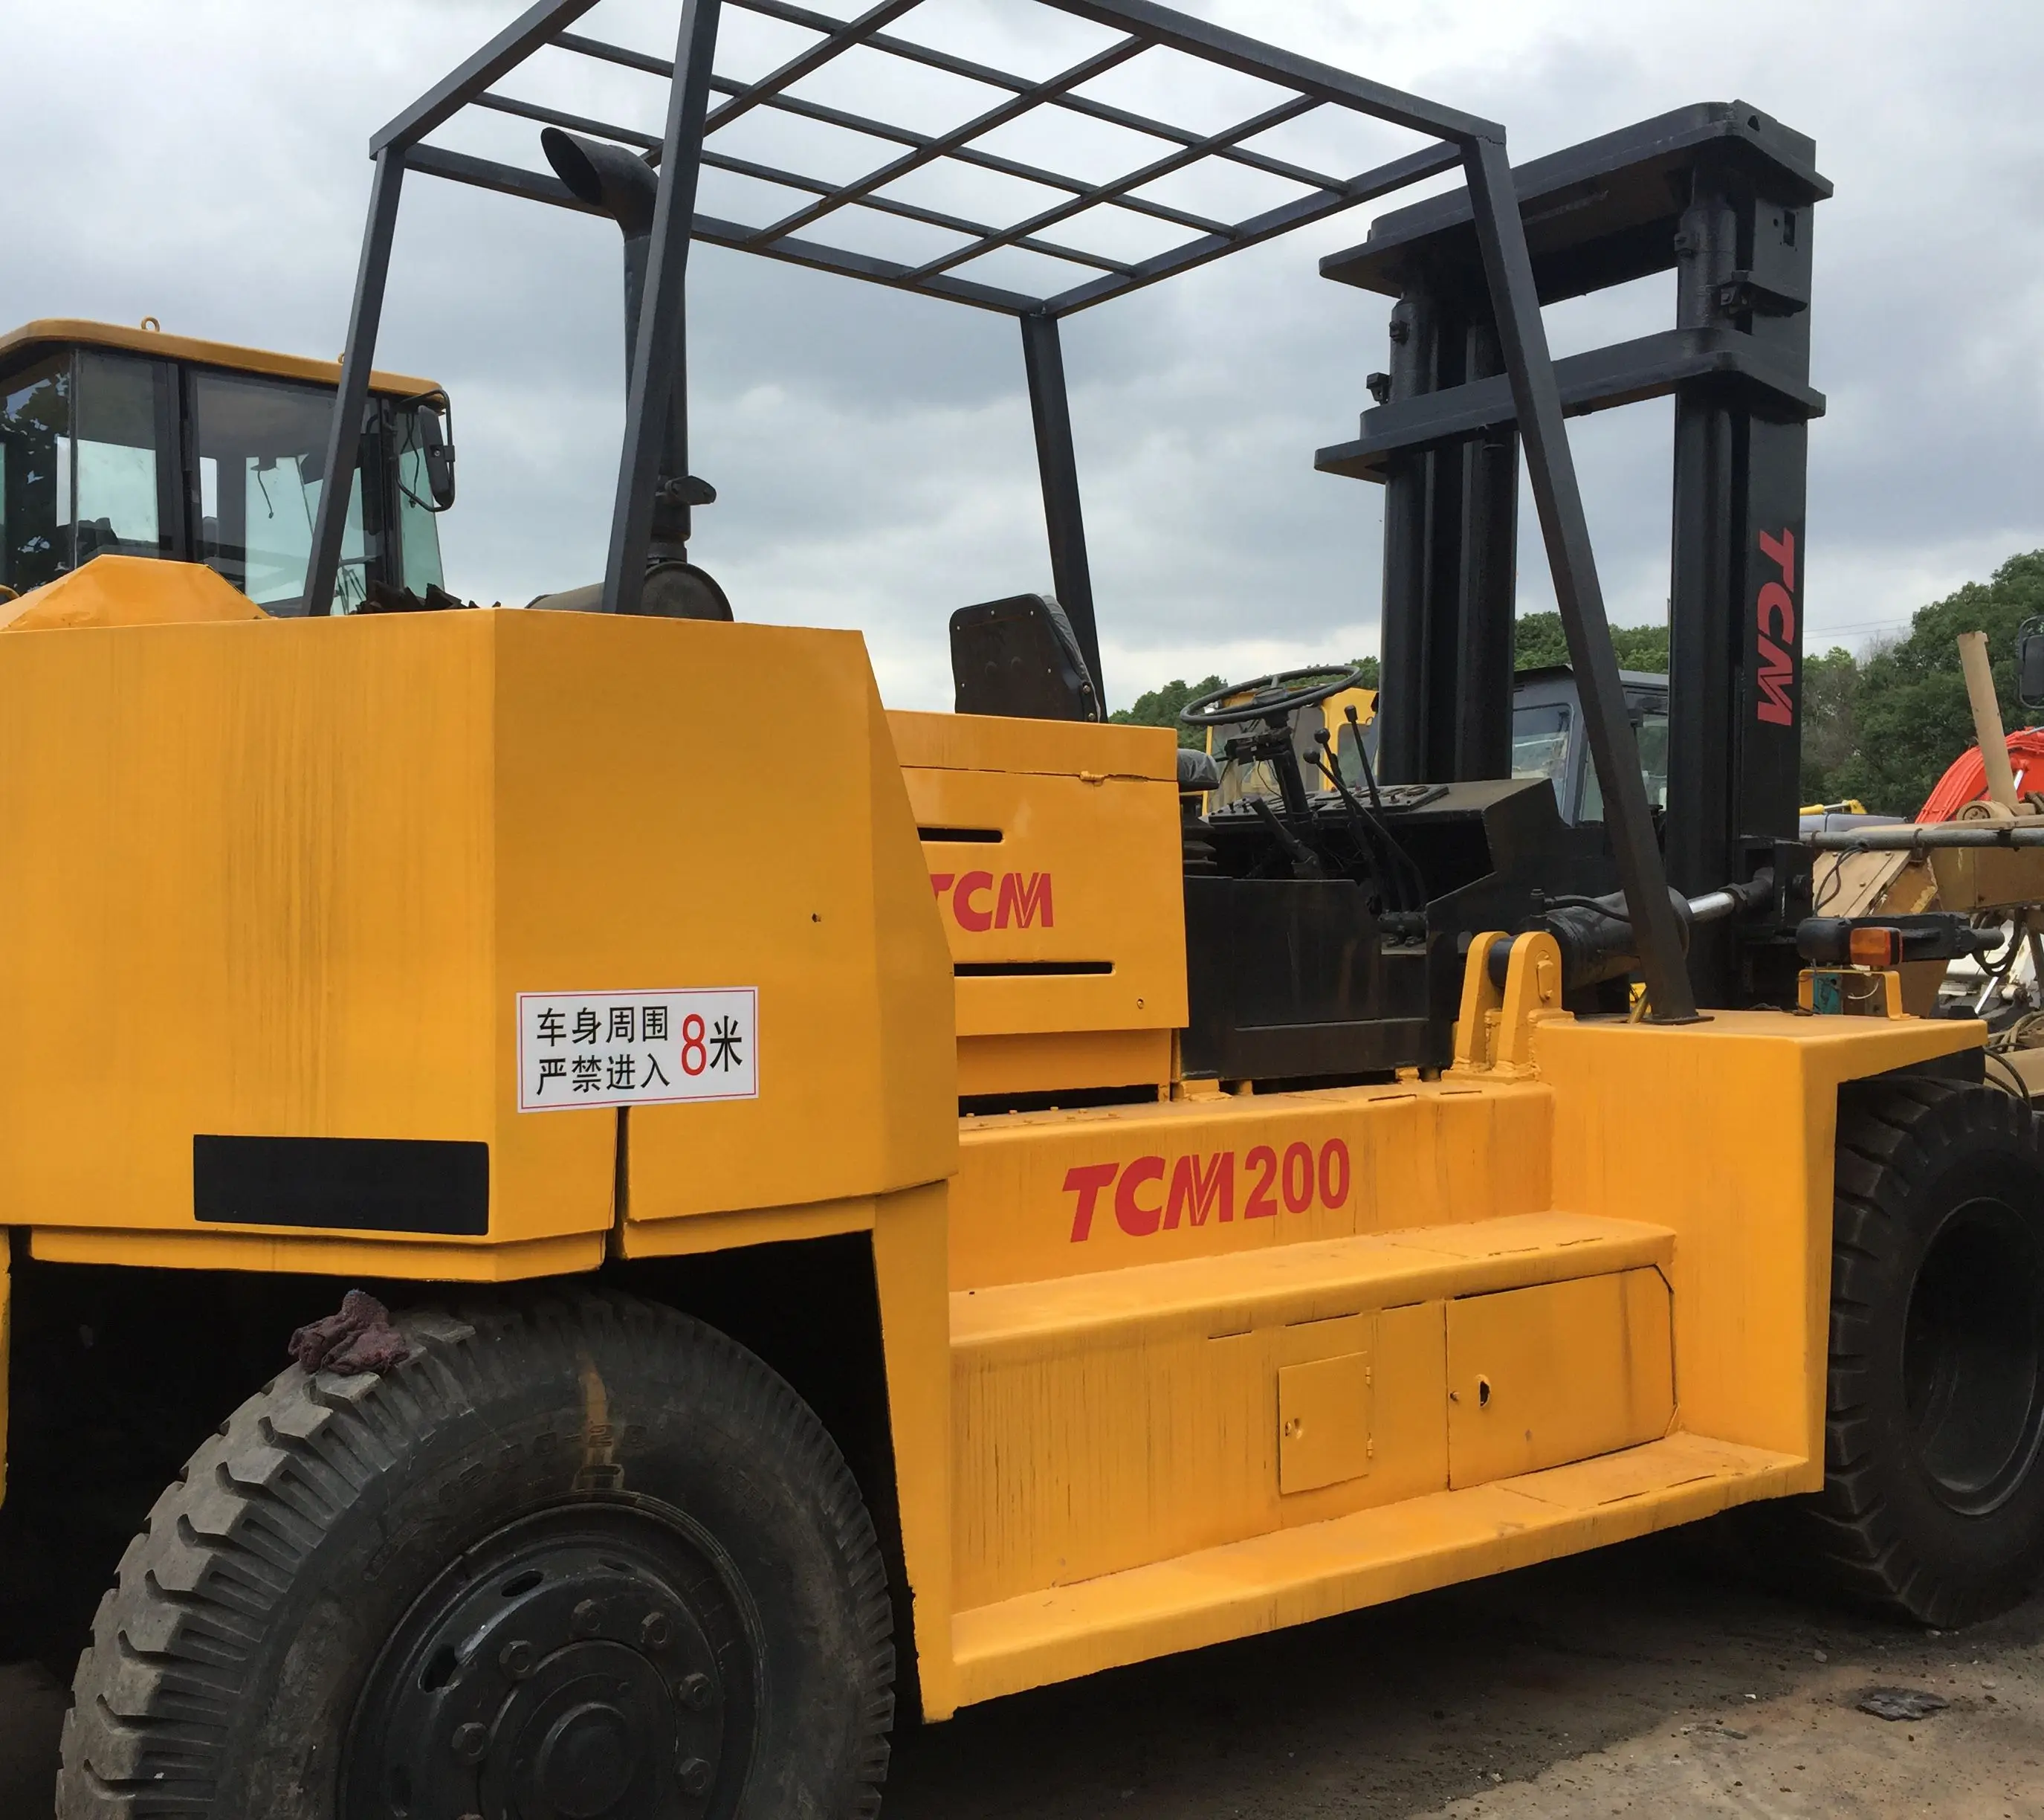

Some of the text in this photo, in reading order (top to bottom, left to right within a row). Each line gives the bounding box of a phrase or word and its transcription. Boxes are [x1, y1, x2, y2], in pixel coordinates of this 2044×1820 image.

[1758, 527, 1794, 726] TCM
[537, 1005, 669, 1047] 车身周围
[536, 1053, 670, 1095] 严禁进入
